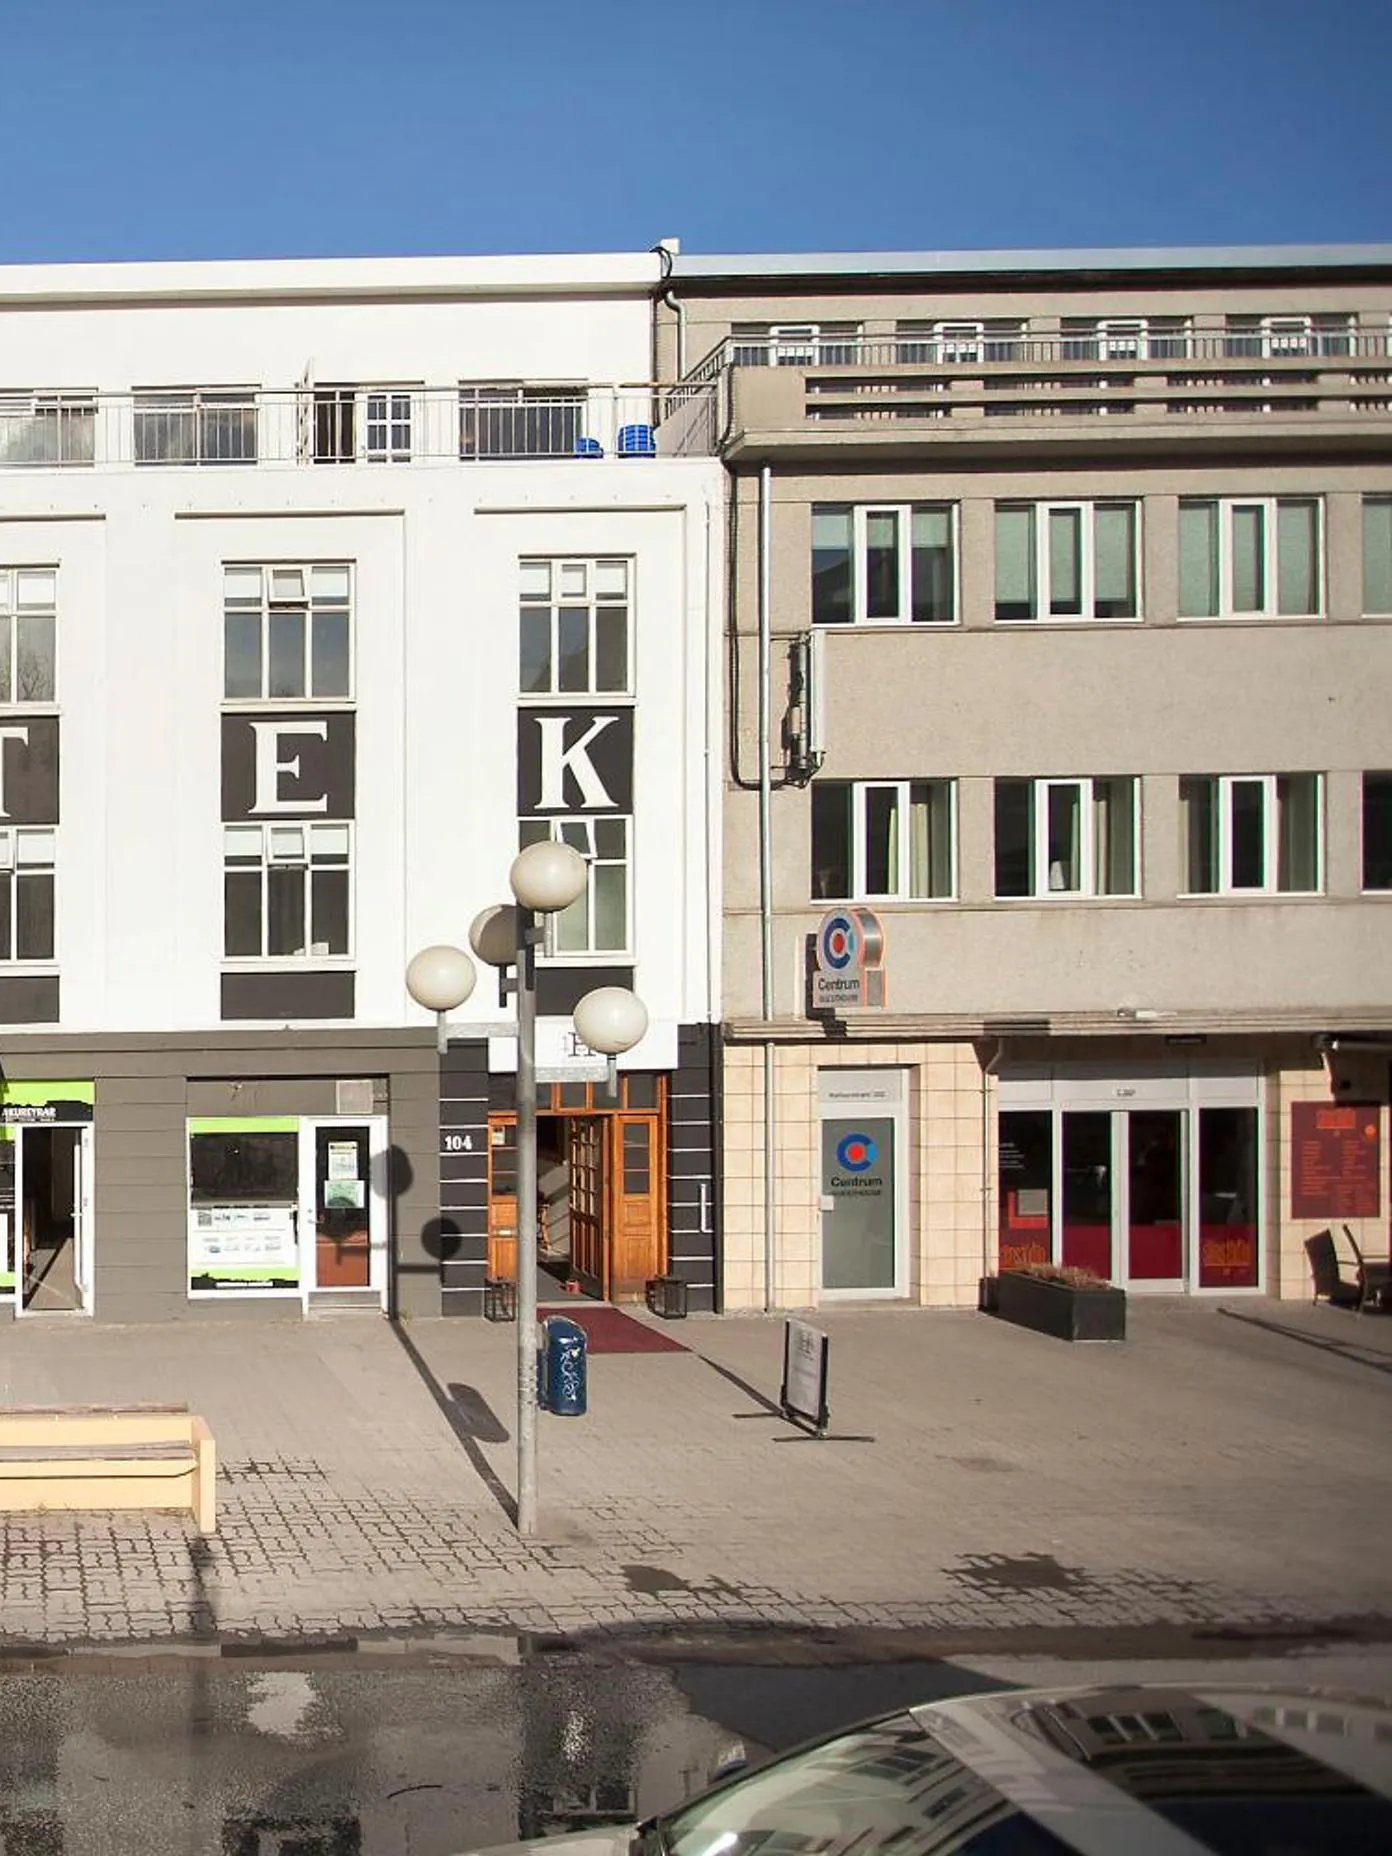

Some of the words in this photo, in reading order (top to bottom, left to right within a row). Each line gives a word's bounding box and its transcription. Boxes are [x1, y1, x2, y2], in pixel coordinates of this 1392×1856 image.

[818, 978, 860, 990] Centrum
[444, 1135, 473, 1151] 104
[830, 1176, 882, 1187] Centrum
